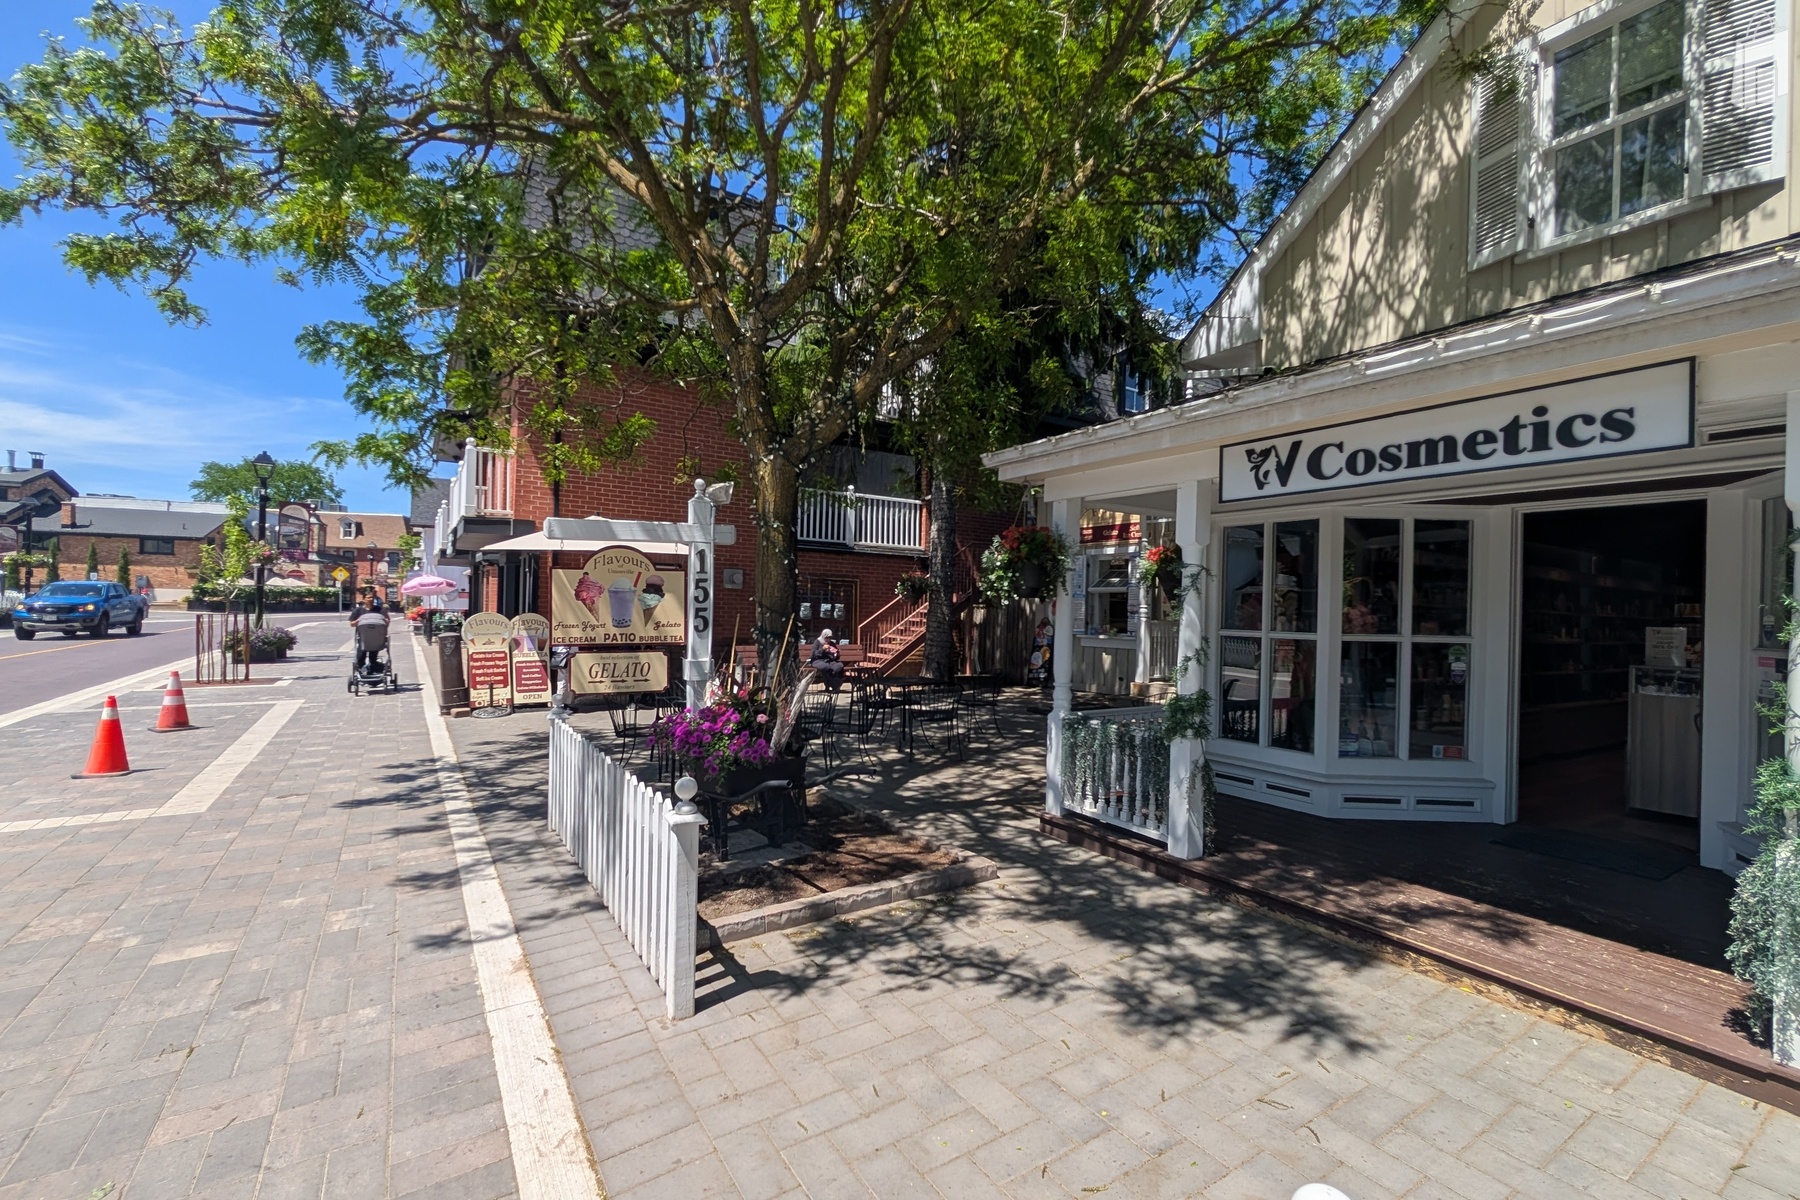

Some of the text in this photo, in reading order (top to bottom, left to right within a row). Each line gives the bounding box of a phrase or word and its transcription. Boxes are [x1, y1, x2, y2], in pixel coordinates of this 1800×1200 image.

[1306, 405, 1636, 482] Cosmetics
[593, 554, 650, 573] Flavours
[694, 549, 710, 633] 155
[468, 618, 508, 629] Flavours
[512, 618, 549, 630] Flavours
[554, 621, 607, 632] Frozen Yogurt
[653, 621, 682, 631] Gelato
[603, 632, 636, 643] PATIO
[588, 661, 651, 679] GELATO
